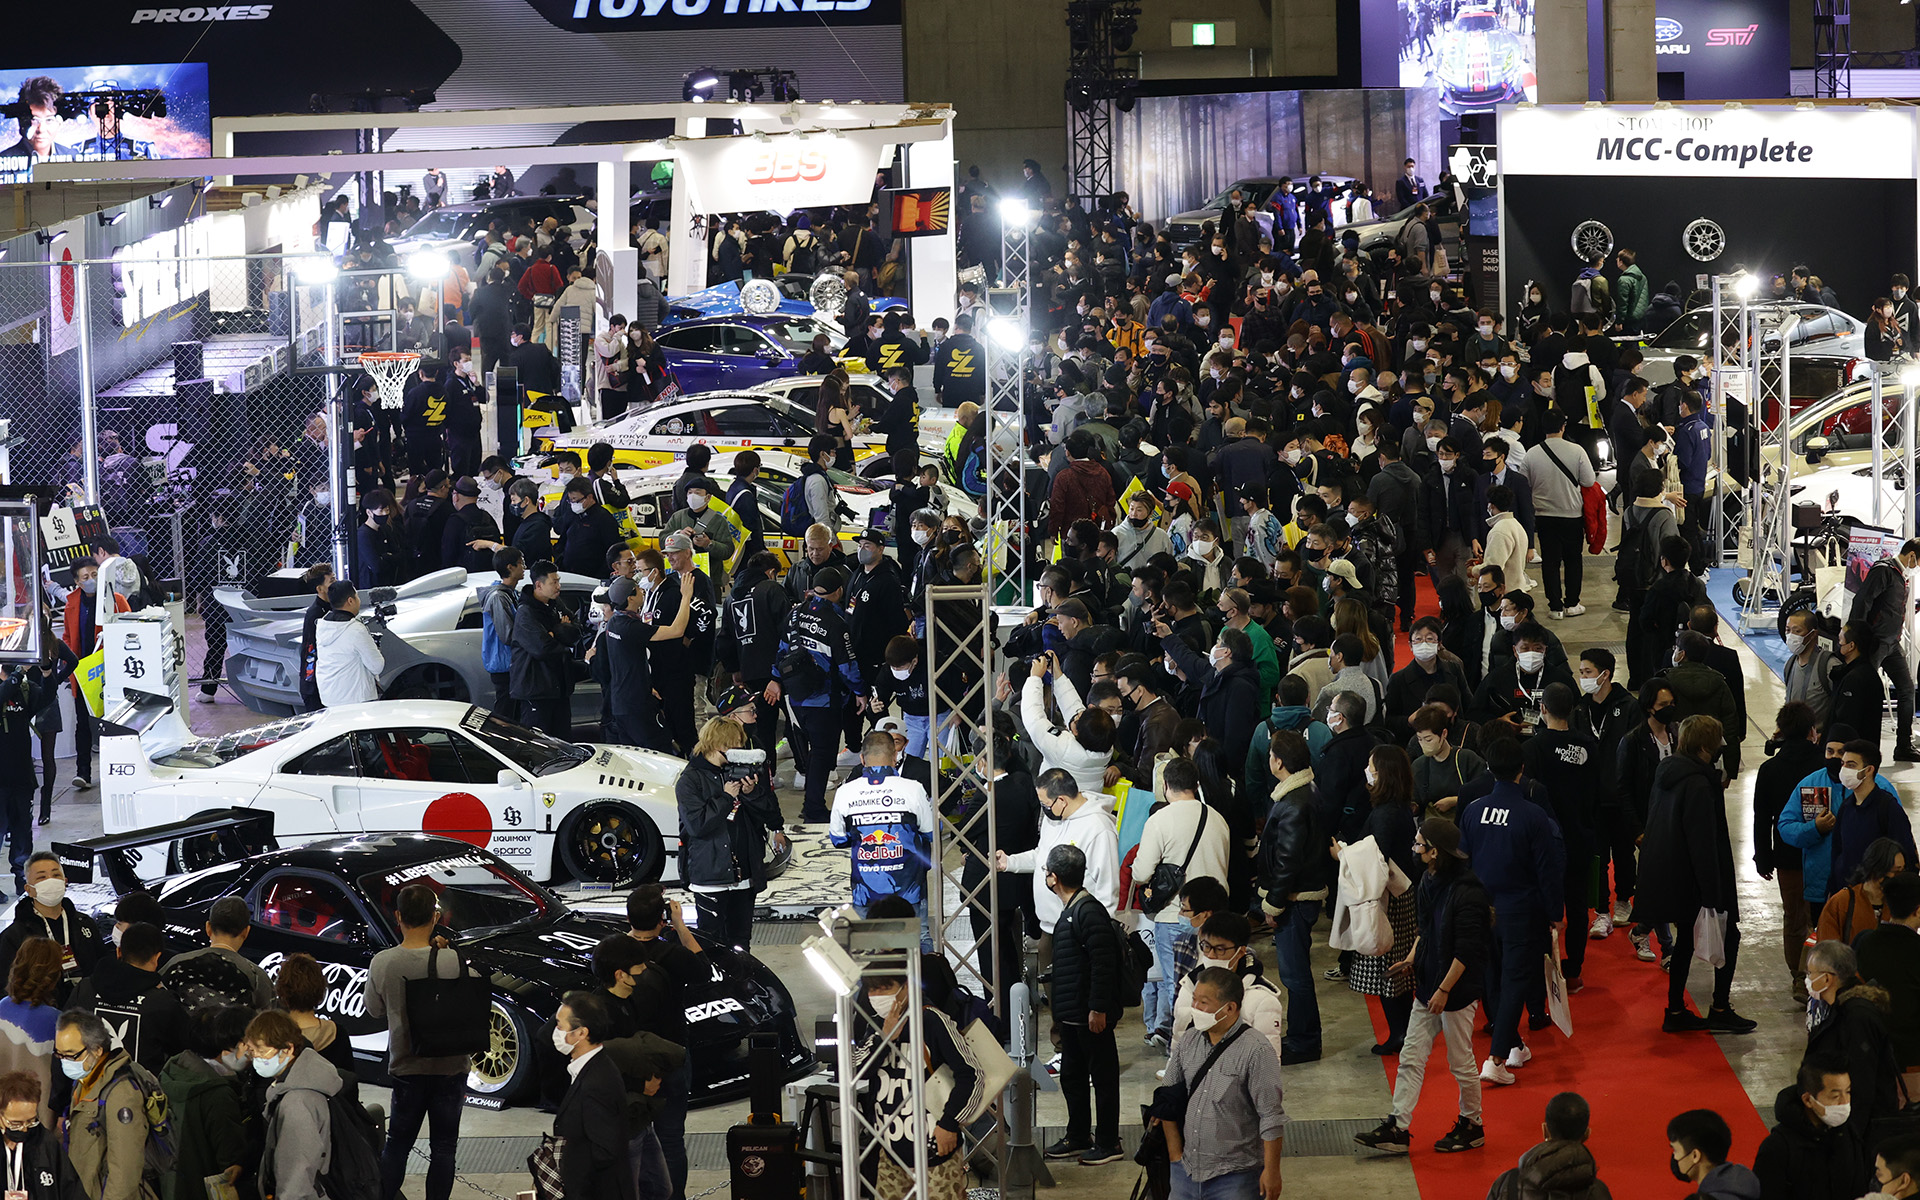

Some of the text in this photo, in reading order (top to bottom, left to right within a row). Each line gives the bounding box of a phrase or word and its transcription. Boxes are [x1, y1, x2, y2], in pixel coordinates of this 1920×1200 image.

[131, 4, 273, 24] PROXES
[572, 0, 711, 19] TOYO
[1656, 44, 1691, 54] BARU
[1596, 136, 1814, 168] MCC-Complete
[748, 150, 827, 185] BBS
[1554, 747, 1580, 757] NORTH
[1567, 744, 1581, 753] THE
[1560, 755, 1578, 764] FACE
[108, 763, 136, 776] F40
[848, 796, 906, 808] MADMIKE 123
[492, 847, 532, 857] sparco
[857, 846, 904, 861] Red Bull
[59, 856, 90, 868] Slammed
[880, 863, 904, 871] TIRES
[538, 931, 602, 951] 20
[464, 1095, 501, 1109] YOKOHAMA
